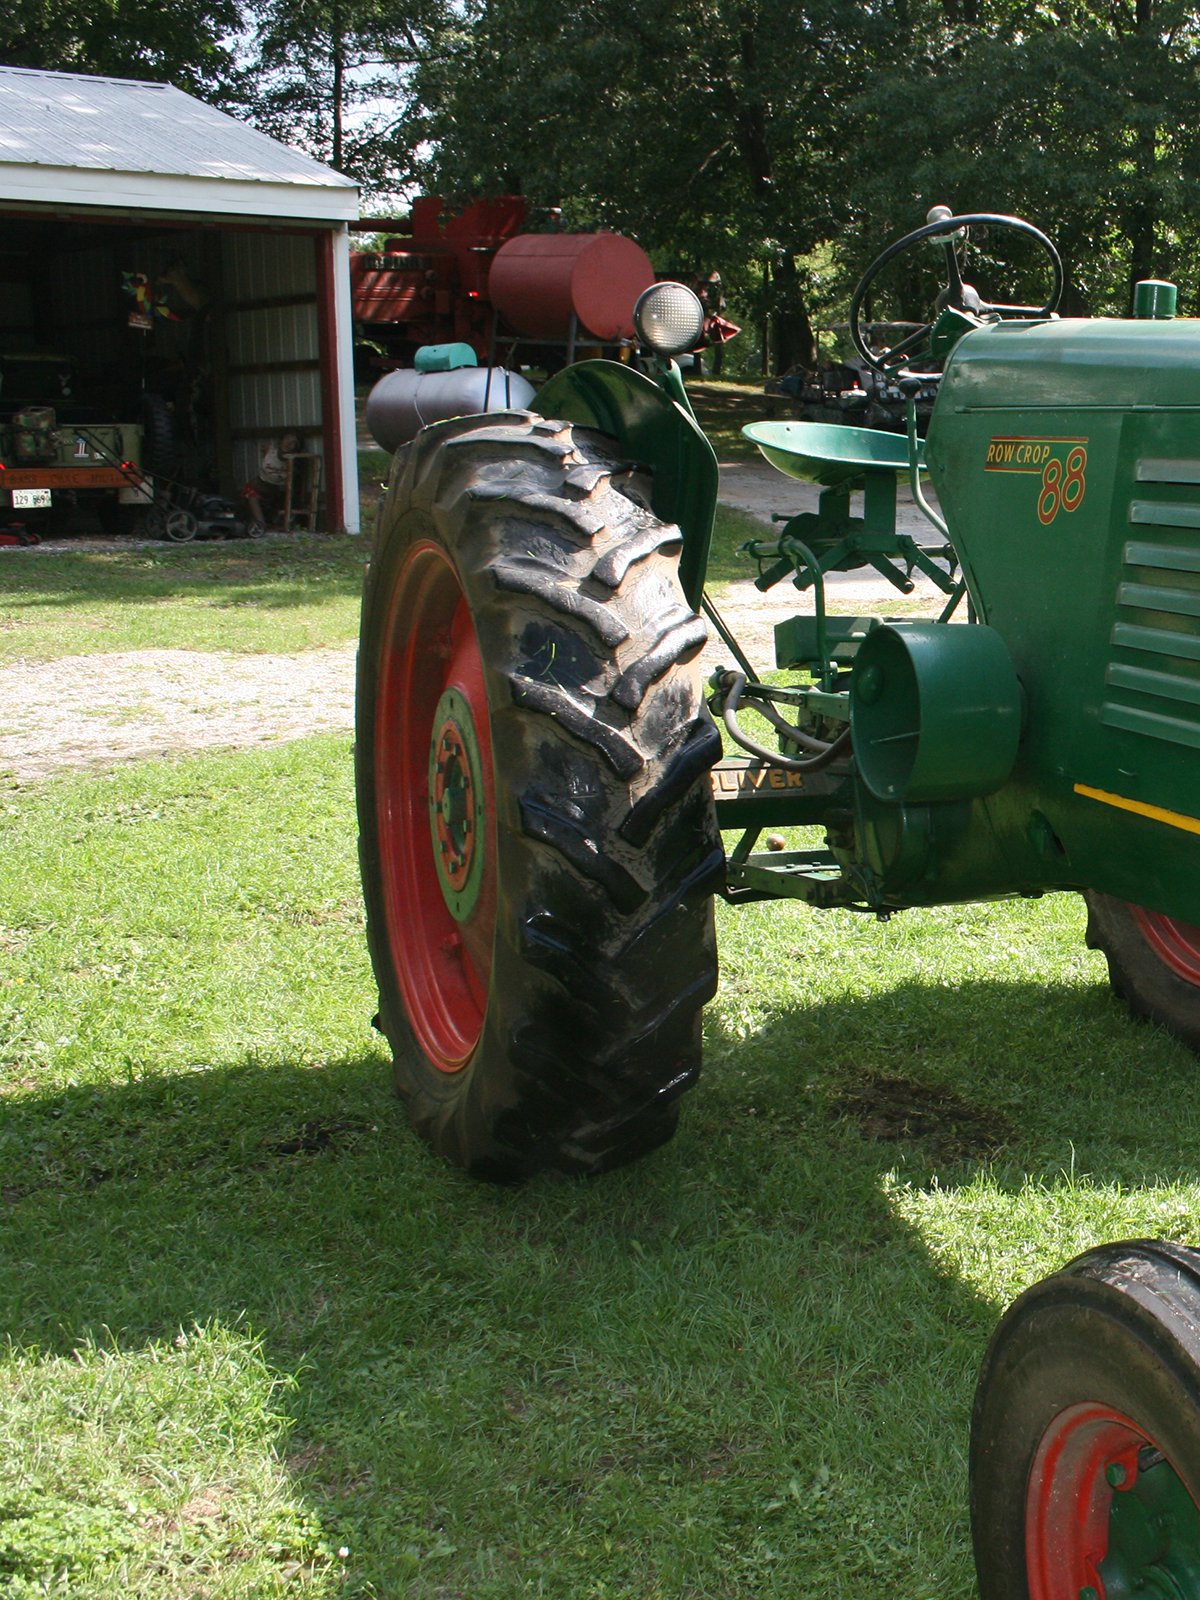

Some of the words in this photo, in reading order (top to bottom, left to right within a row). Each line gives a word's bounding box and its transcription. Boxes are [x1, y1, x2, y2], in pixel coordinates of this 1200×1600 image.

[987, 444, 1015, 463] ROW
[1016, 445, 1050, 464] CROP
[1037, 446, 1087, 525] 88
